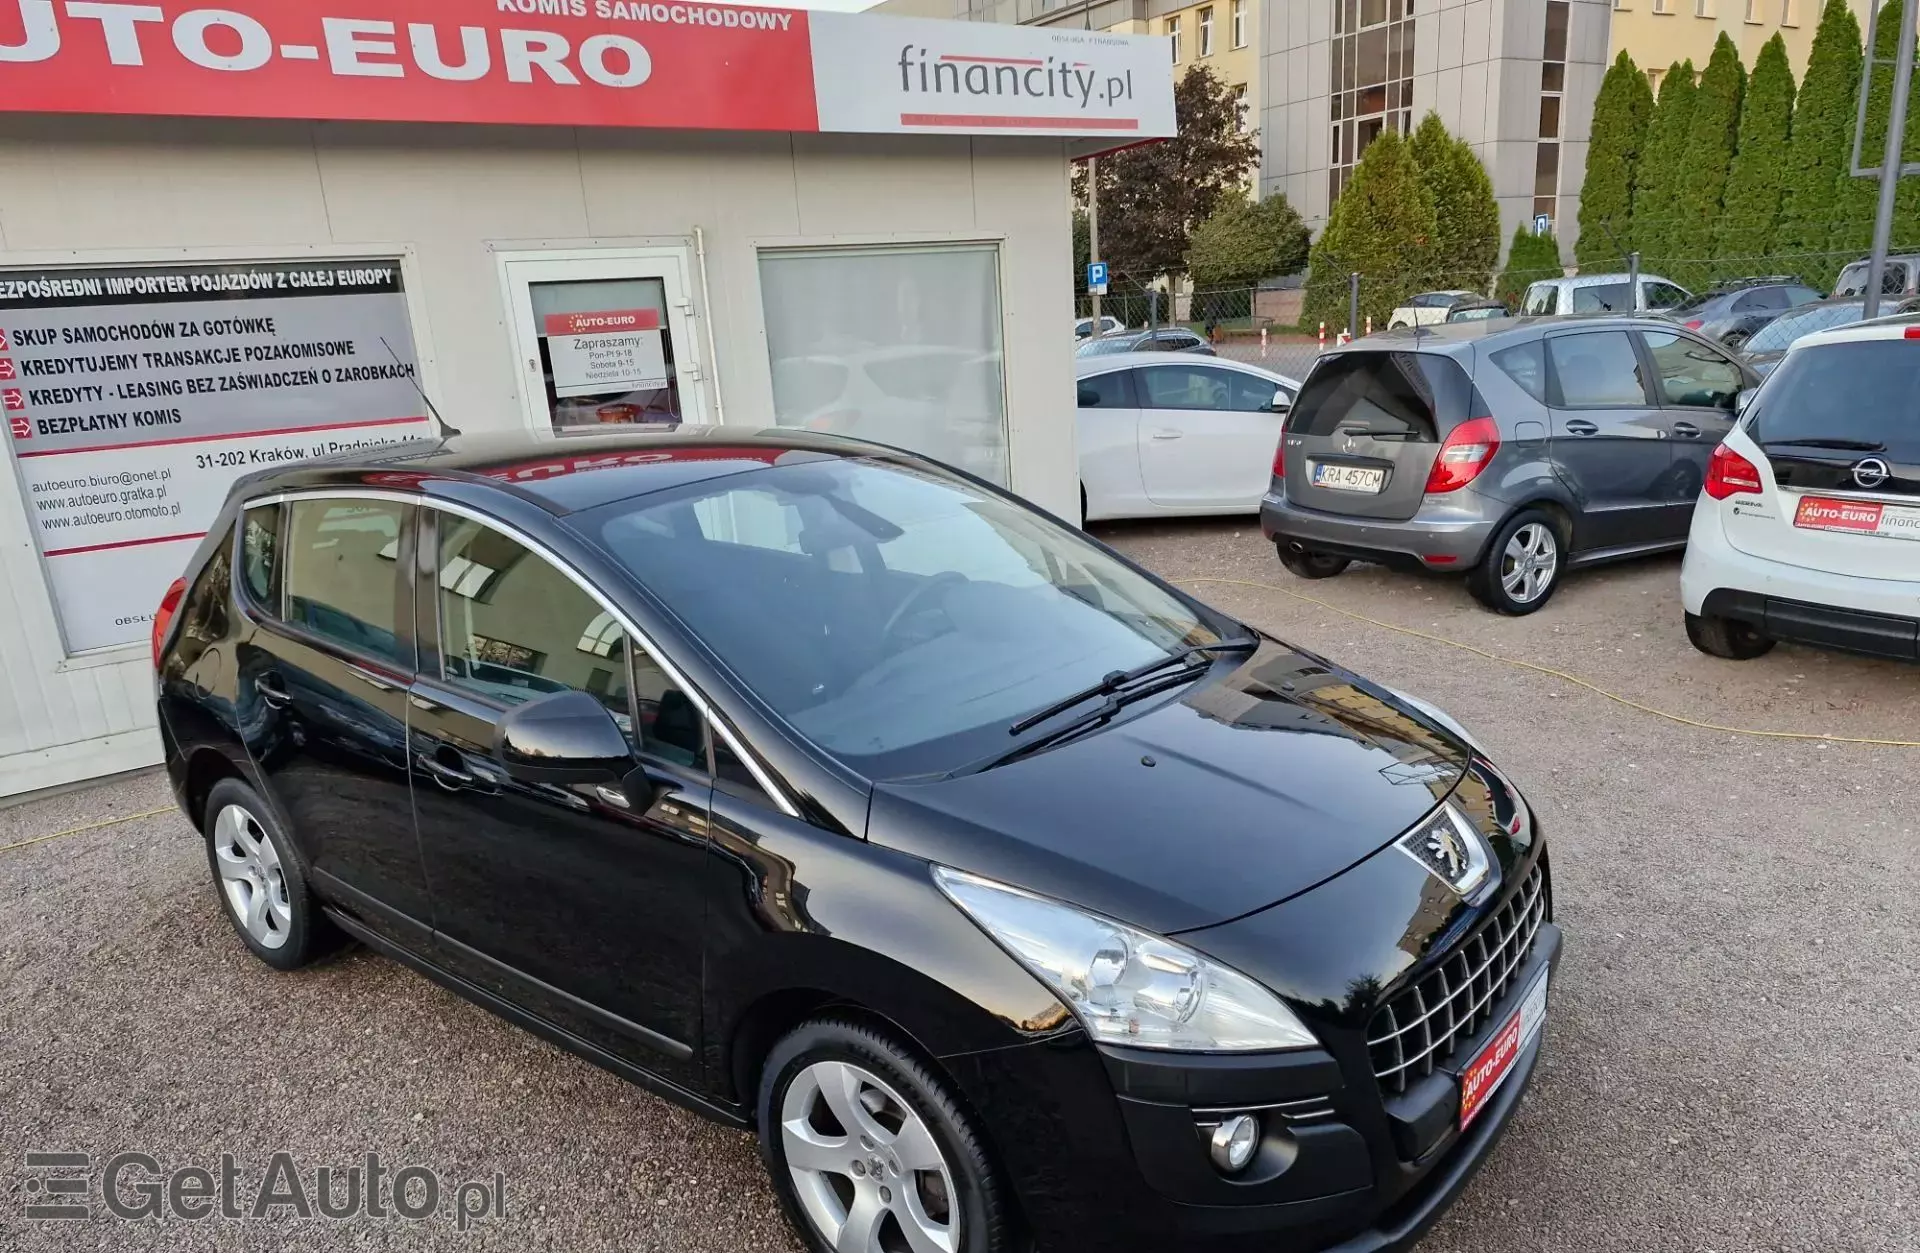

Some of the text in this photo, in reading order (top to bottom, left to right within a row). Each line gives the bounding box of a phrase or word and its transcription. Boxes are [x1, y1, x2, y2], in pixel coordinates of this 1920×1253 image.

[595, 0, 792, 30] SAMOCHODOWY
[898, 44, 1132, 108] financity.pl
[105, 274, 188, 295] IMPORTER
[190, 269, 273, 292] POJAZDÓW
[275, 271, 288, 289] Z
[289, 270, 334, 288] CAŁEJ
[337, 268, 392, 286] EUROPY
[13, 316, 276, 346] SKUP SAMOCHODÓW ZA GOTÓWKĘ
[575, 315, 636, 328] AUTO-EURO
[20, 341, 356, 376] KREDYTUJEMY TRANSAKCJE POZAKOMISOWE
[590, 361, 616, 370] Sobota
[29, 386, 103, 406] KREDYTY
[117, 380, 183, 399] LEASING
[187, 378, 216, 394] BEZ
[218, 366, 319, 392] ZAŚWIADCZEŃ
[322, 369, 332, 384] O
[335, 363, 415, 383] ZAROBKACH
[37, 408, 182, 435] BEZPŁATNY KOMIS
[196, 451, 246, 469] 31-202
[32, 468, 172, 493] autoeuro.biuro@onet.pl
[1320, 466, 1341, 483] KRA
[1345, 469, 1382, 488] 457CM
[36, 484, 167, 511] www.autoeuro.gratka.pl
[41, 502, 181, 530] www.autoeuro.otomoto.pl
[1804, 507, 1877, 522] AUTO-EURO
[1466, 1027, 1518, 1099] AUTO-EURO
